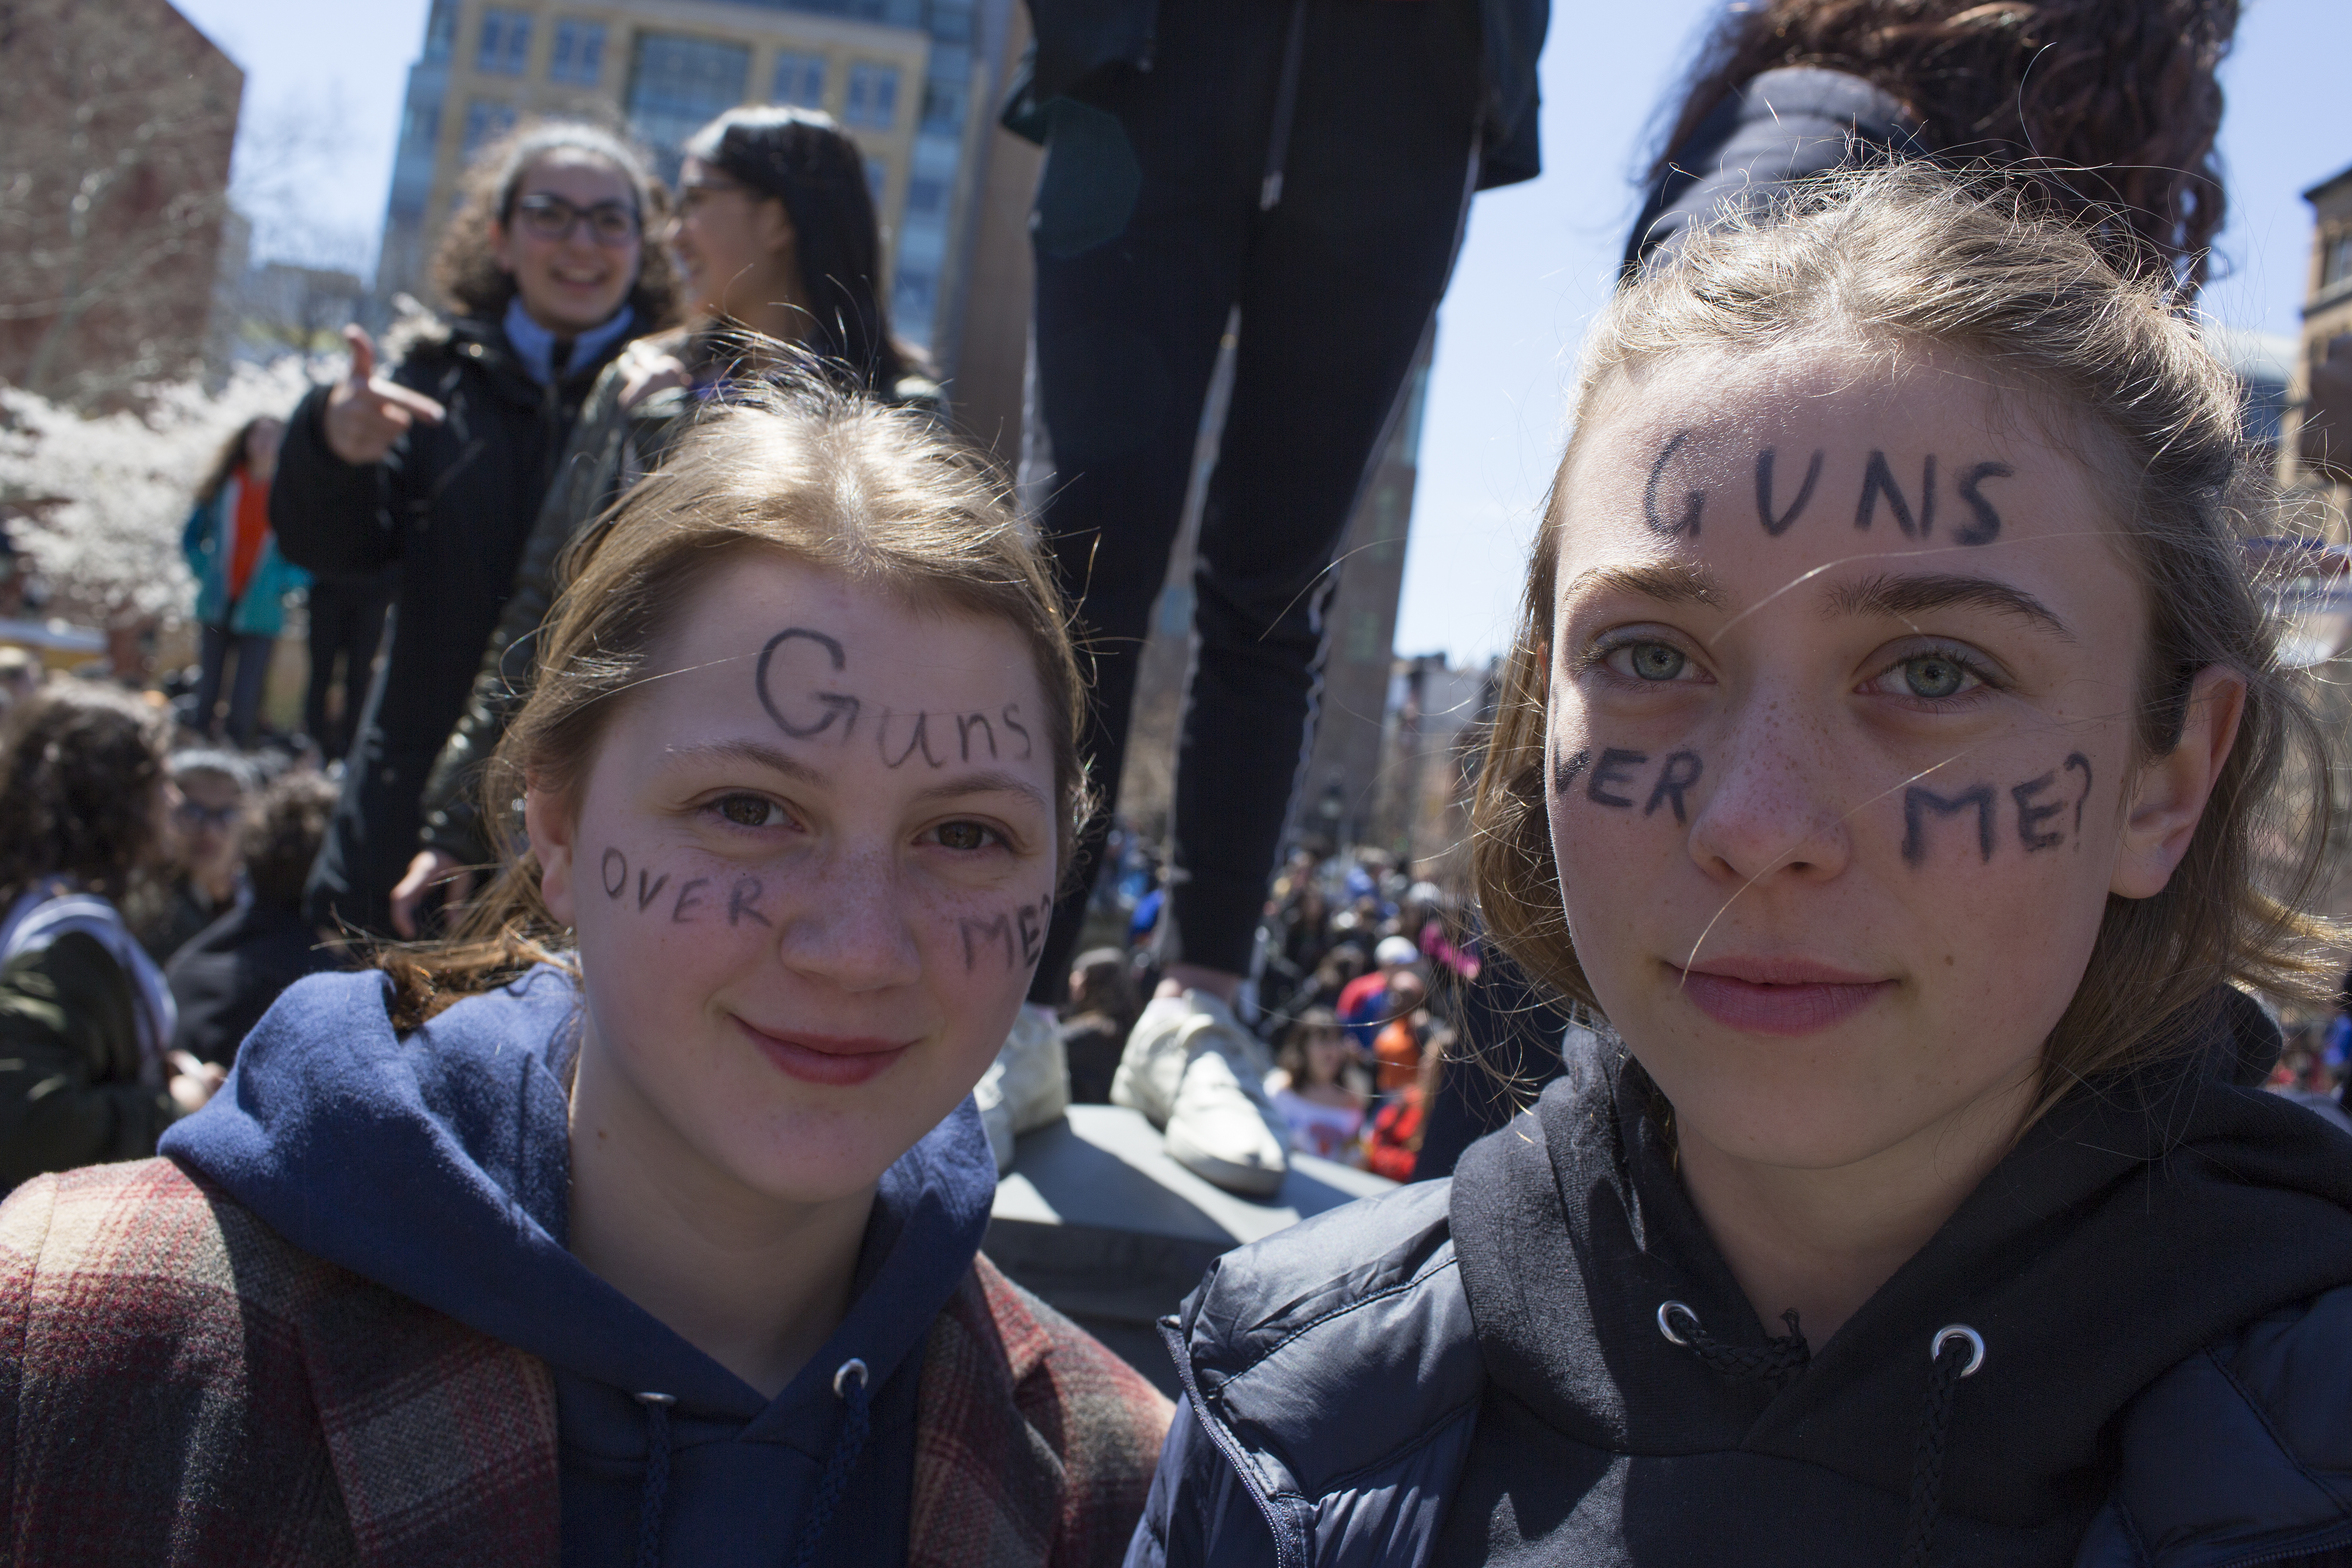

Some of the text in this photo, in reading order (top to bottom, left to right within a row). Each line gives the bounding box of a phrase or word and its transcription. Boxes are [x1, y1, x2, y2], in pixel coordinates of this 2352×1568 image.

[1643, 429, 2013, 546] GUNS
[755, 627, 1031, 768] Guns
[1549, 733, 2092, 869] VER ME?
[601, 846, 1051, 972] OVER ME?
